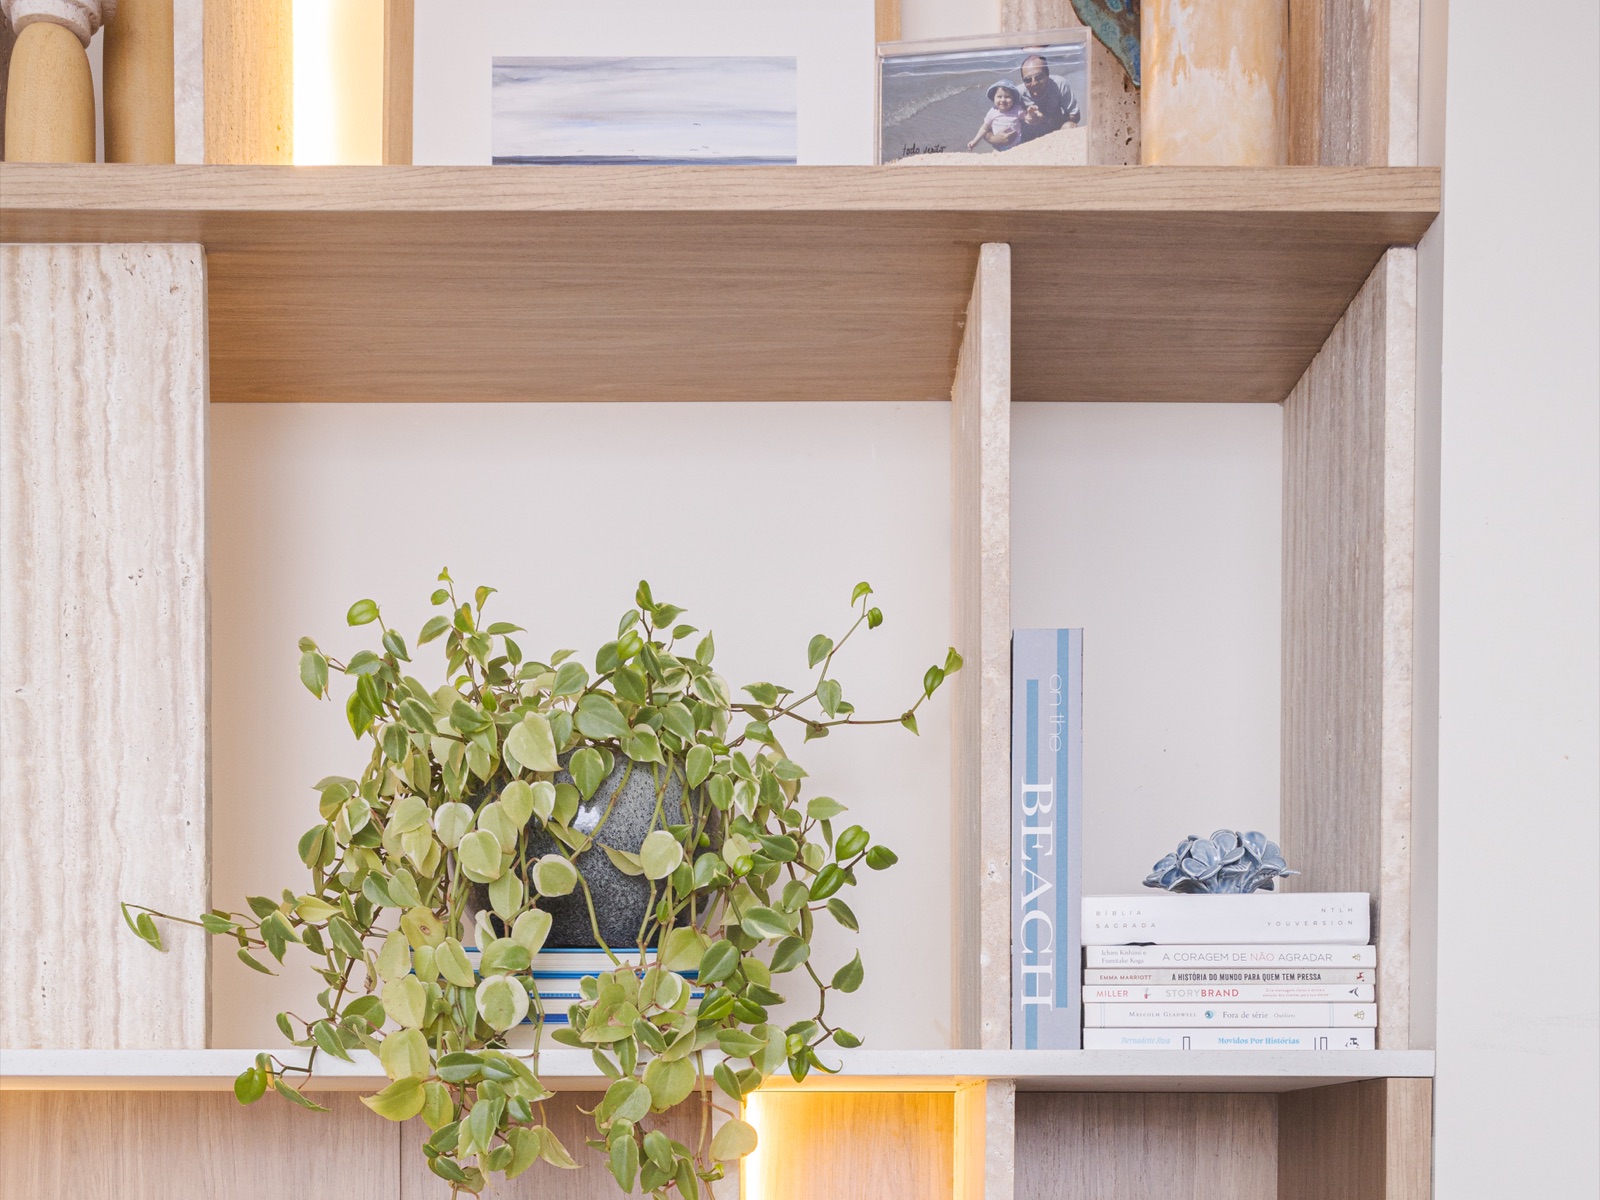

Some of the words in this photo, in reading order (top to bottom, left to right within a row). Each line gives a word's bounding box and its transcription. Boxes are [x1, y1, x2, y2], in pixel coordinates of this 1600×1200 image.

[1049, 674, 1063, 706] on
[1048, 713, 1066, 752] the
[1020, 776, 1054, 1012] BEACH
[1266, 919, 1353, 927] YOUVERSION
[1130, 957, 1145, 965] Koga
[1163, 952, 1171, 961] A
[1173, 952, 1229, 962] CORAGEM
[1232, 953, 1247, 962] DE
[1250, 951, 1275, 962] NÃO
[1278, 953, 1333, 962] AGRADAR
[1172, 973, 1177, 981] A
[1178, 971, 1207, 981] HISTÓRIA
[1209, 973, 1218, 981] DO
[1220, 973, 1243, 981] MUNDO
[1244, 973, 1261, 981] PARA
[1262, 973, 1281, 982] QUEM
[1282, 973, 1296, 981] TEM
[1297, 973, 1322, 981] PRESSA
[1097, 989, 1129, 998] MILLER
[1166, 988, 1239, 997] STORYBRAND
[1265, 1036, 1300, 1044] Histórias
